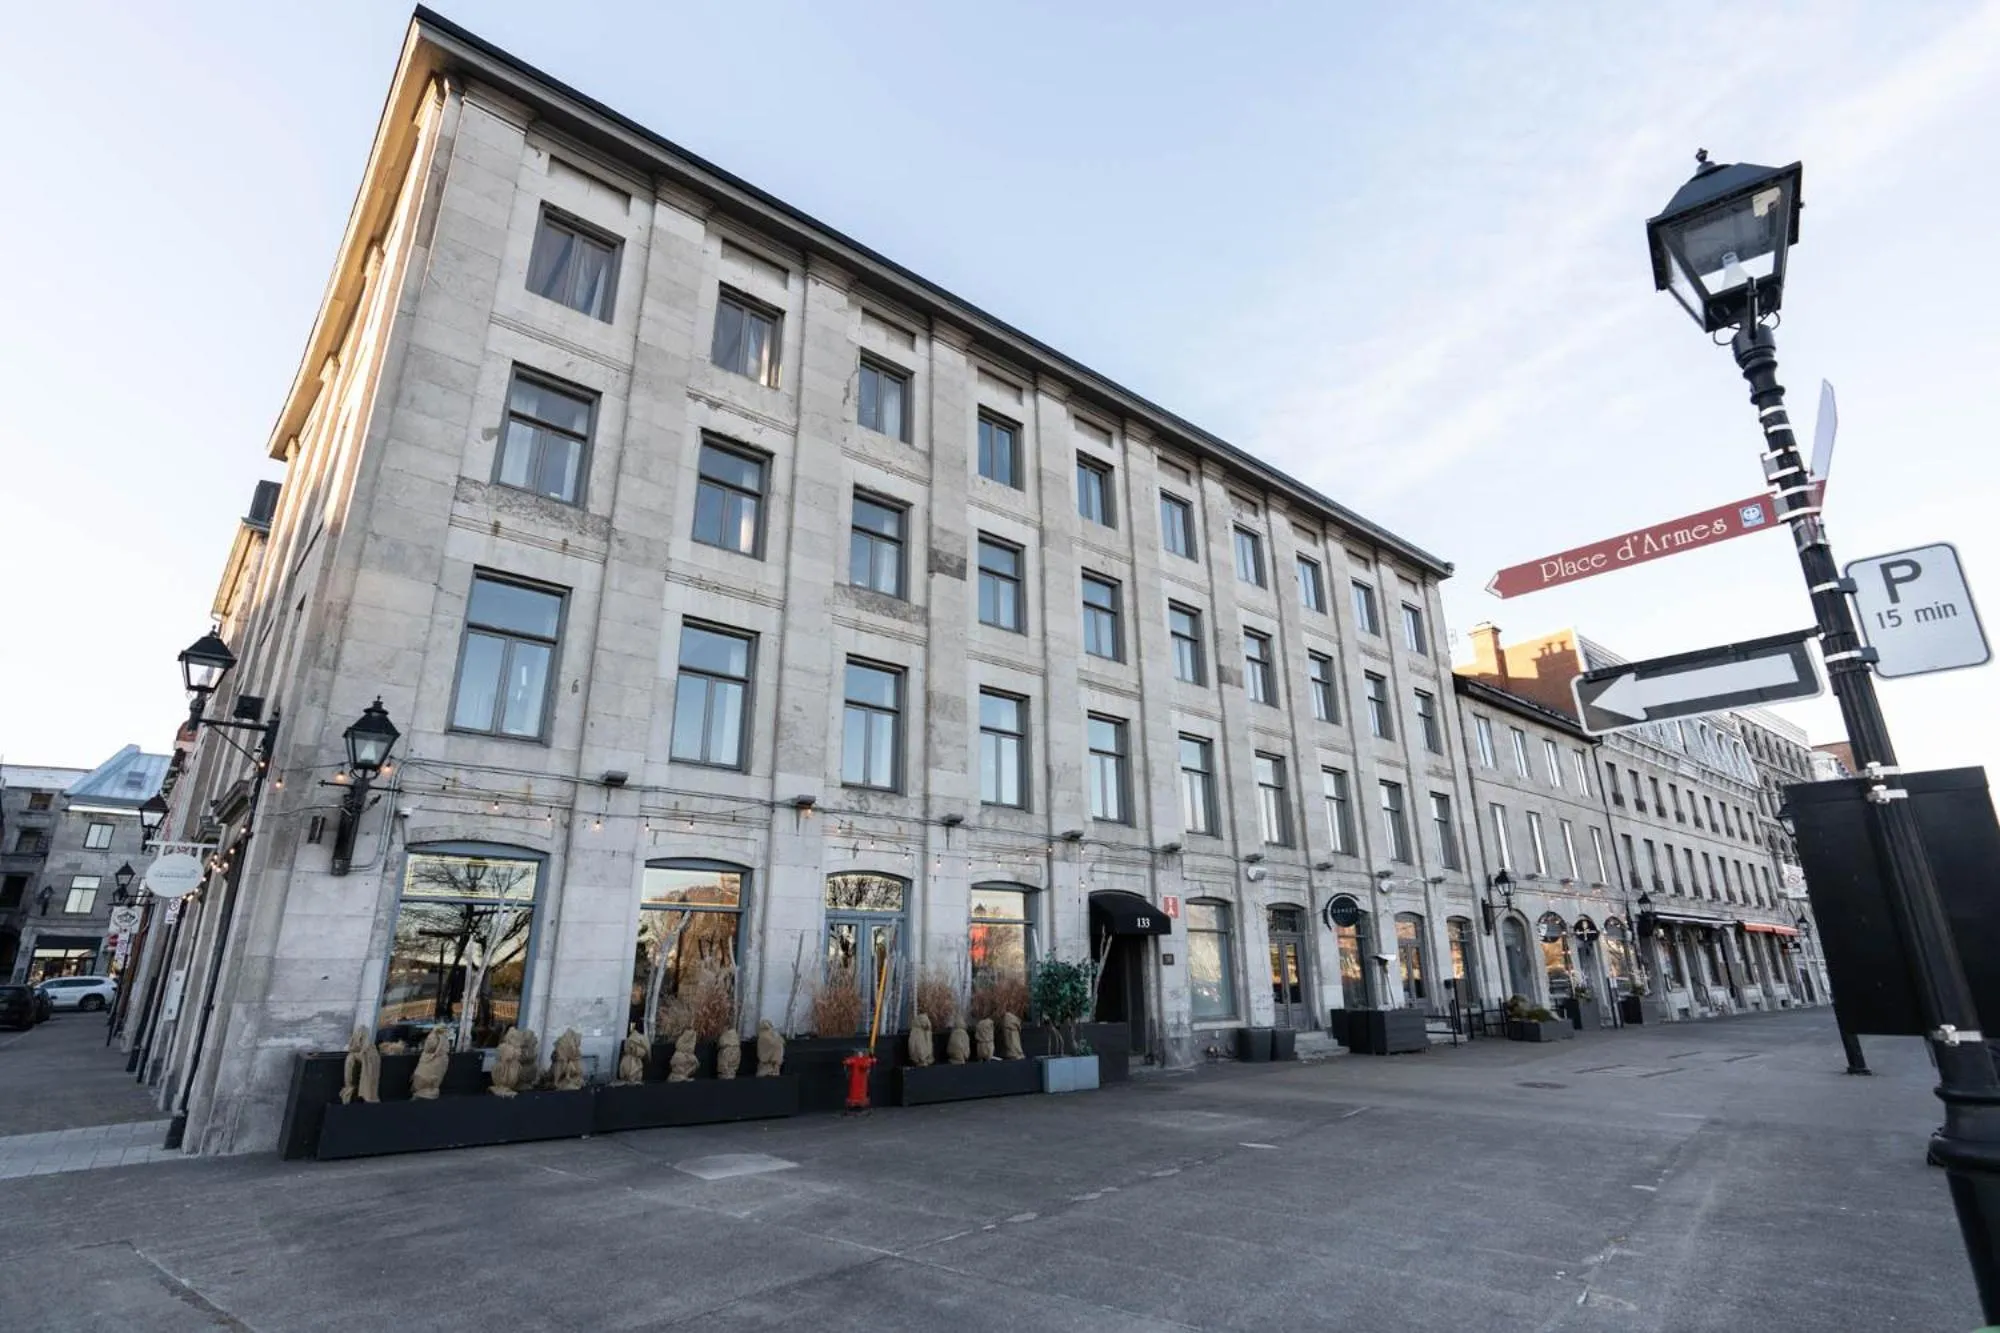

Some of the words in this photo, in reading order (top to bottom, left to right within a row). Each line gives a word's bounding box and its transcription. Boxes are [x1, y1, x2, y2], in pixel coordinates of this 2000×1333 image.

[1540, 553, 1608, 582] Place
[1616, 517, 1728, 561] d'Armes
[1879, 559, 1922, 604] P
[1876, 608, 1903, 629] 15
[1914, 601, 1958, 623] min
[1136, 917, 1150, 928] 133
